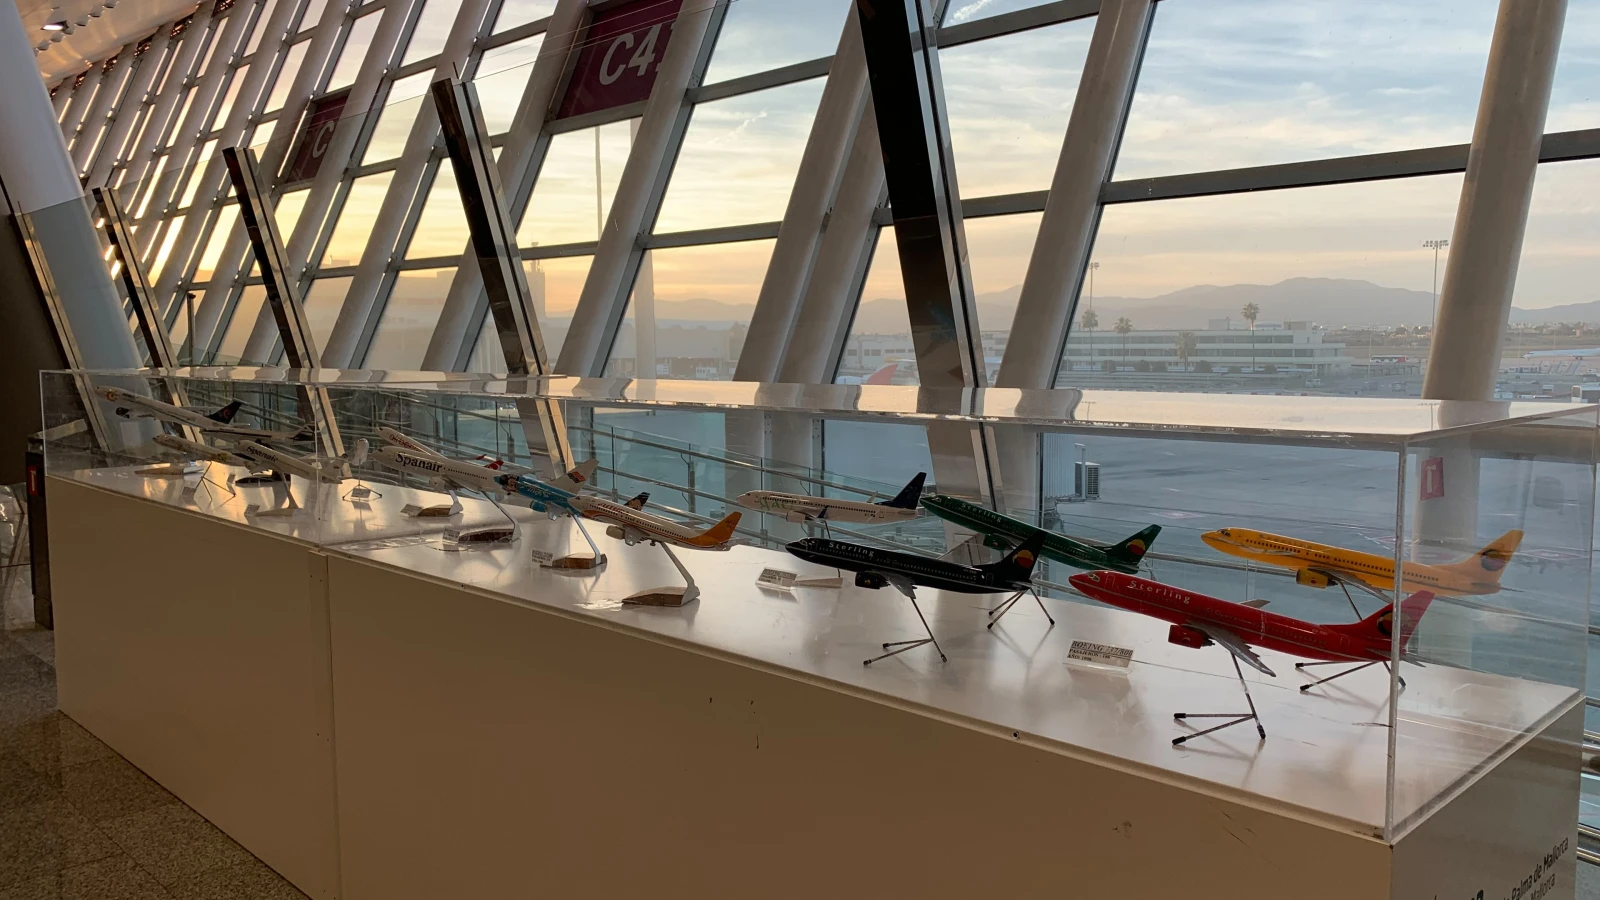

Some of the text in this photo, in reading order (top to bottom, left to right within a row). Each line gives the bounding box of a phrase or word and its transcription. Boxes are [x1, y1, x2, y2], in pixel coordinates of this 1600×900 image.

[599, 21, 677, 86] C4
[395, 451, 443, 473] Spanair
[961, 502, 1002, 524] Sterling
[828, 541, 875, 558] Sterling
[1130, 580, 1191, 605] Sterling
[1071, 640, 1104, 652] BOEING
[1511, 874, 1532, 900] Palma
[1533, 863, 1542, 884] de
[1543, 837, 1569, 874] Mallorca
